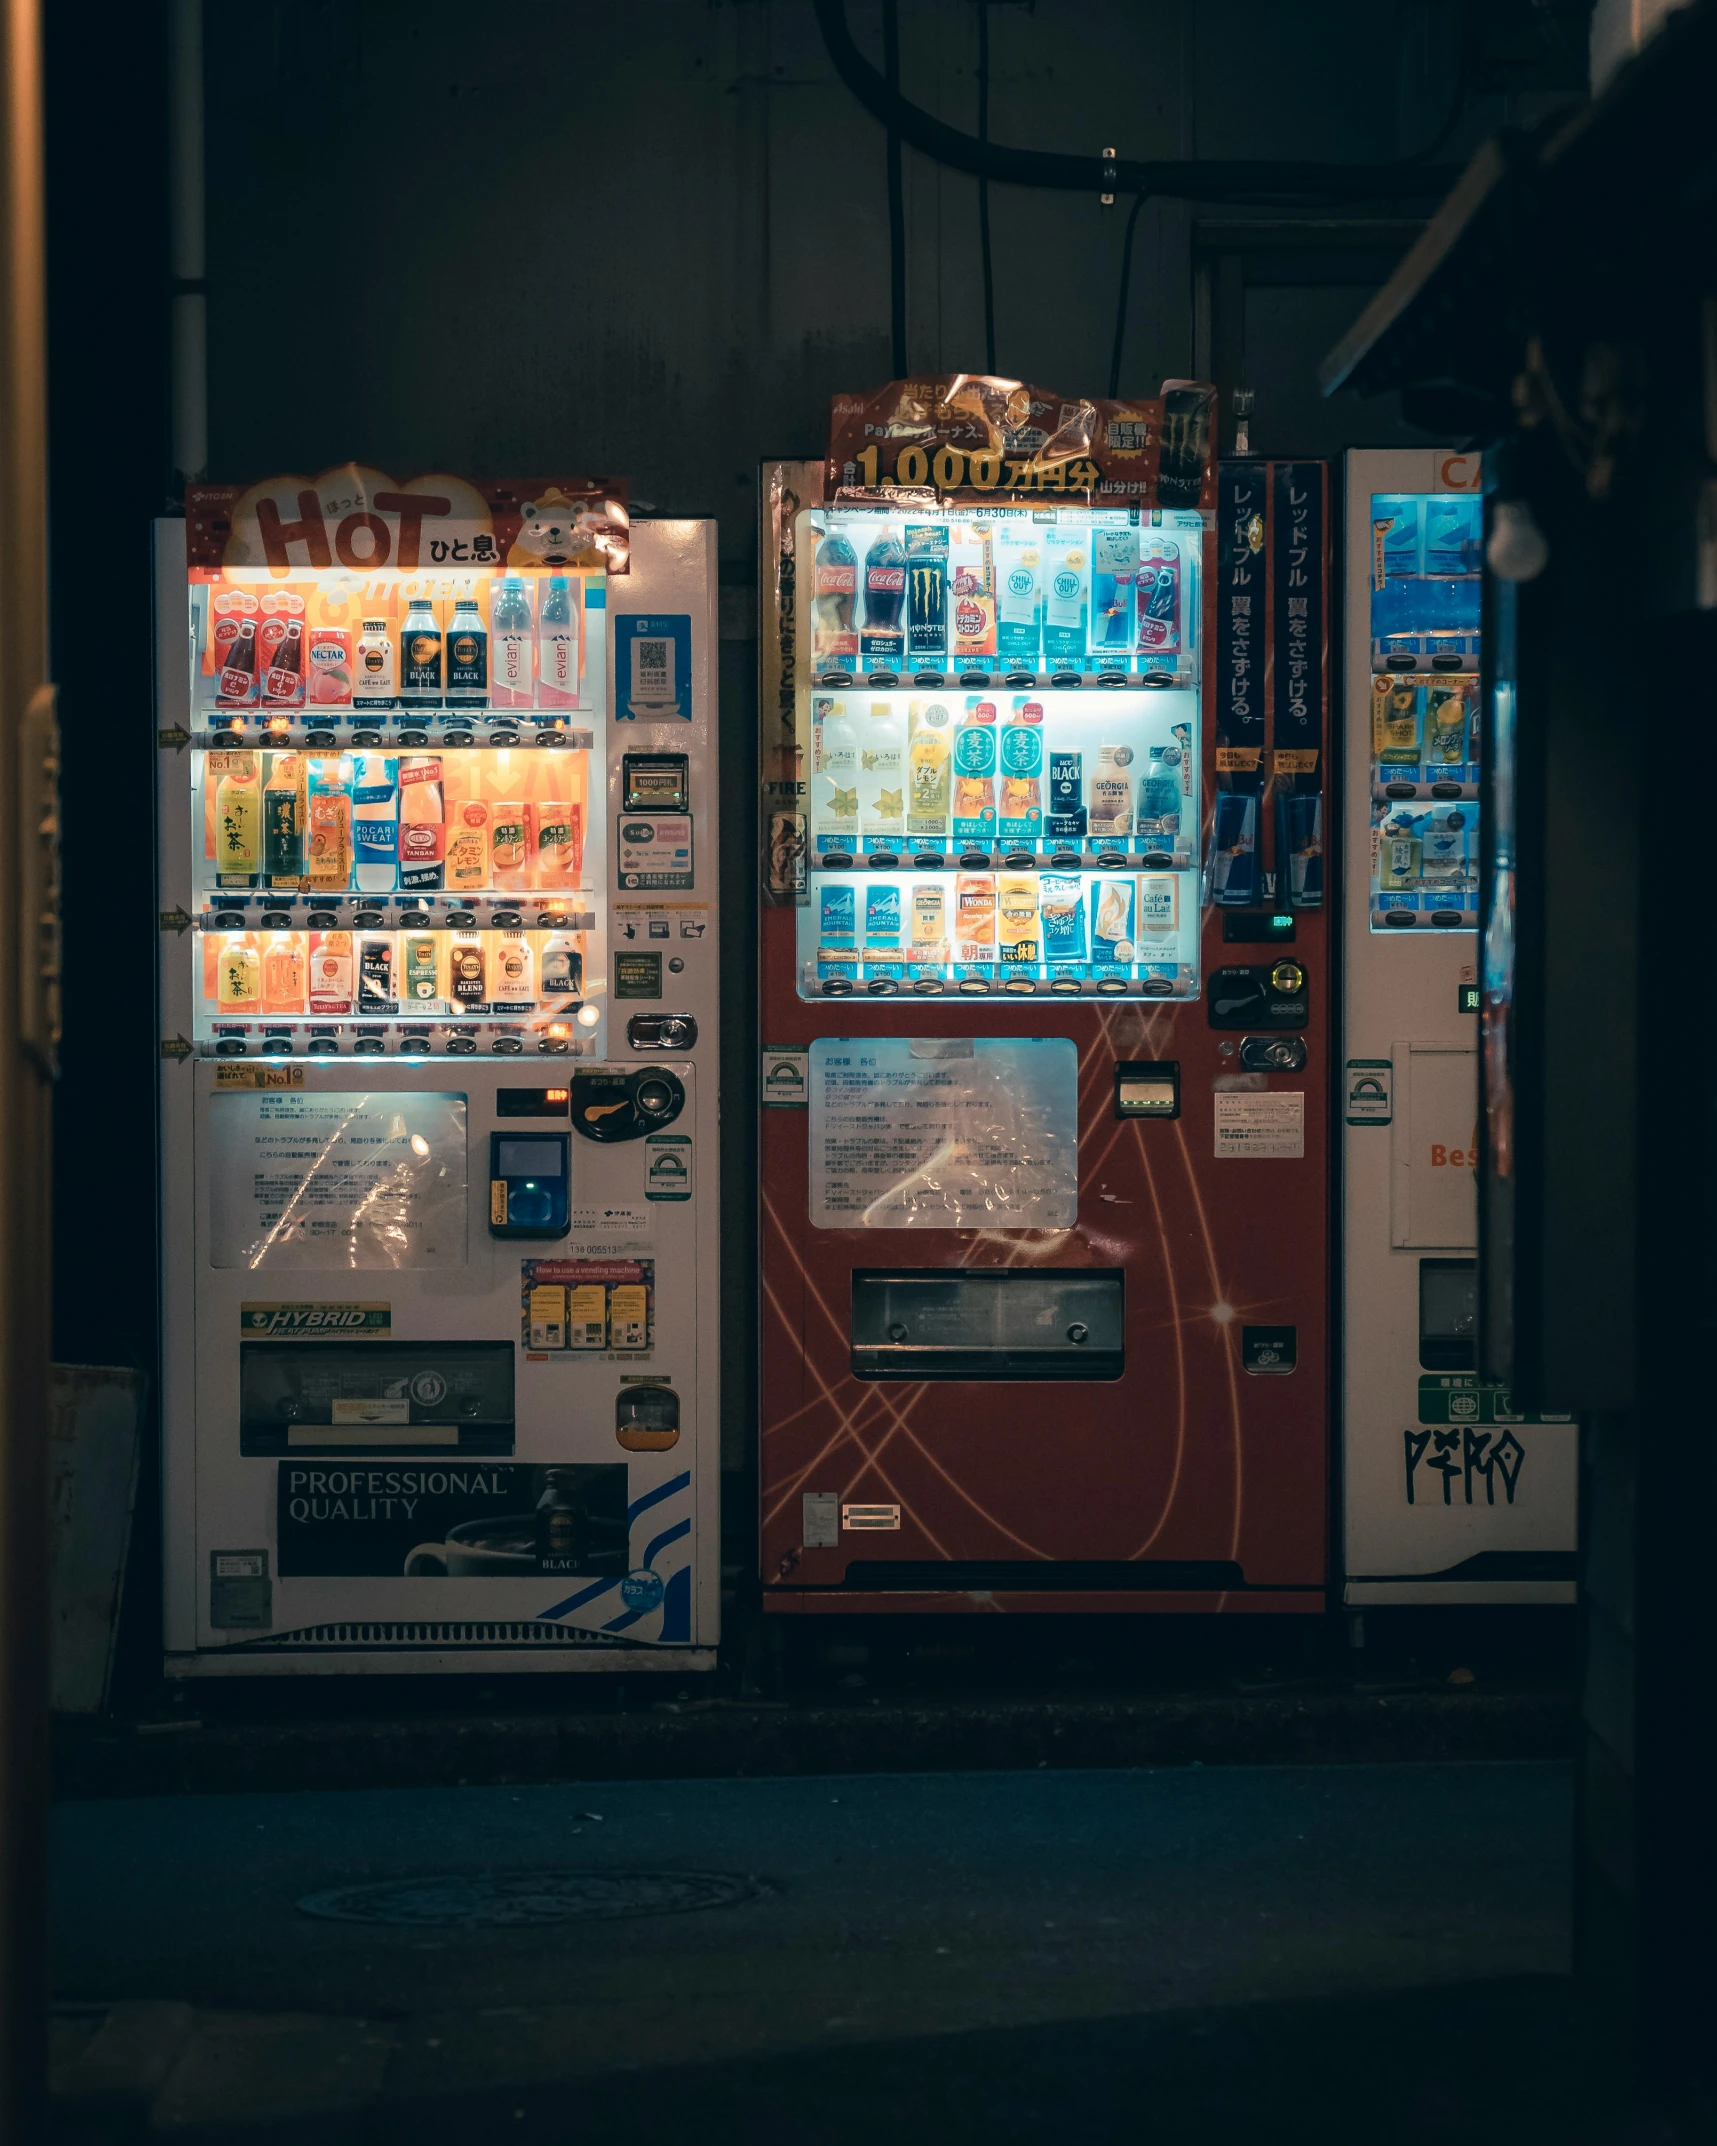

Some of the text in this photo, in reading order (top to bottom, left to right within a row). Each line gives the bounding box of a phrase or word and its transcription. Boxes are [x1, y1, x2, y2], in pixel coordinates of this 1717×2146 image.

[1108, 423, 1147, 435] 自販機
[326, 494, 365, 514] ほっと
[430, 535, 498, 562] ひと息
[1011, 575, 1031, 585] CHILL
[1056, 577, 1077, 587] CHILL
[1014, 582, 1028, 591] OUT
[1059, 585, 1074, 594] OUT
[1231, 485, 1251, 724] レッドブル 翼をさずける。
[1288, 487, 1308, 725] レッドブル 翼をさずける。
[311, 650, 344, 660] NECTAR
[507, 643, 518, 678] evian
[557, 643, 567, 678] evian
[410, 671, 435, 680] BLACK
[453, 671, 479, 680] BLACK
[967, 732, 983, 766] 麦茶
[1013, 732, 1029, 766] 麦茶
[209, 757, 230, 769] No.1
[1052, 767, 1080, 780] BLACK
[769, 782, 806, 795] FIRE
[1096, 781, 1128, 790] GEORGIA
[224, 816, 245, 852] お茶
[457, 857, 480, 865] レモン
[964, 898, 992, 906] WONDA
[1144, 893, 1163, 903] Café
[961, 945, 978, 960] 朝
[365, 962, 389, 971] BLACK
[229, 967, 247, 996] お茶
[550, 979, 575, 987] BLACK
[458, 984, 482, 992] BLEND
[825, 1057, 876, 1066] お客様 各位
[267, 1065, 291, 1084] No.1
[262, 1097, 282, 1105] お客様
[587, 1246, 617, 1254] 005513
[536, 1266, 552, 1274] How
[581, 1266, 609, 1276] vending
[610, 1266, 640, 1274] machine
[267, 1312, 366, 1335] HYBRID
[290, 1471, 507, 1494] PROFESSIONAL
[290, 1498, 418, 1523] QUALITY
